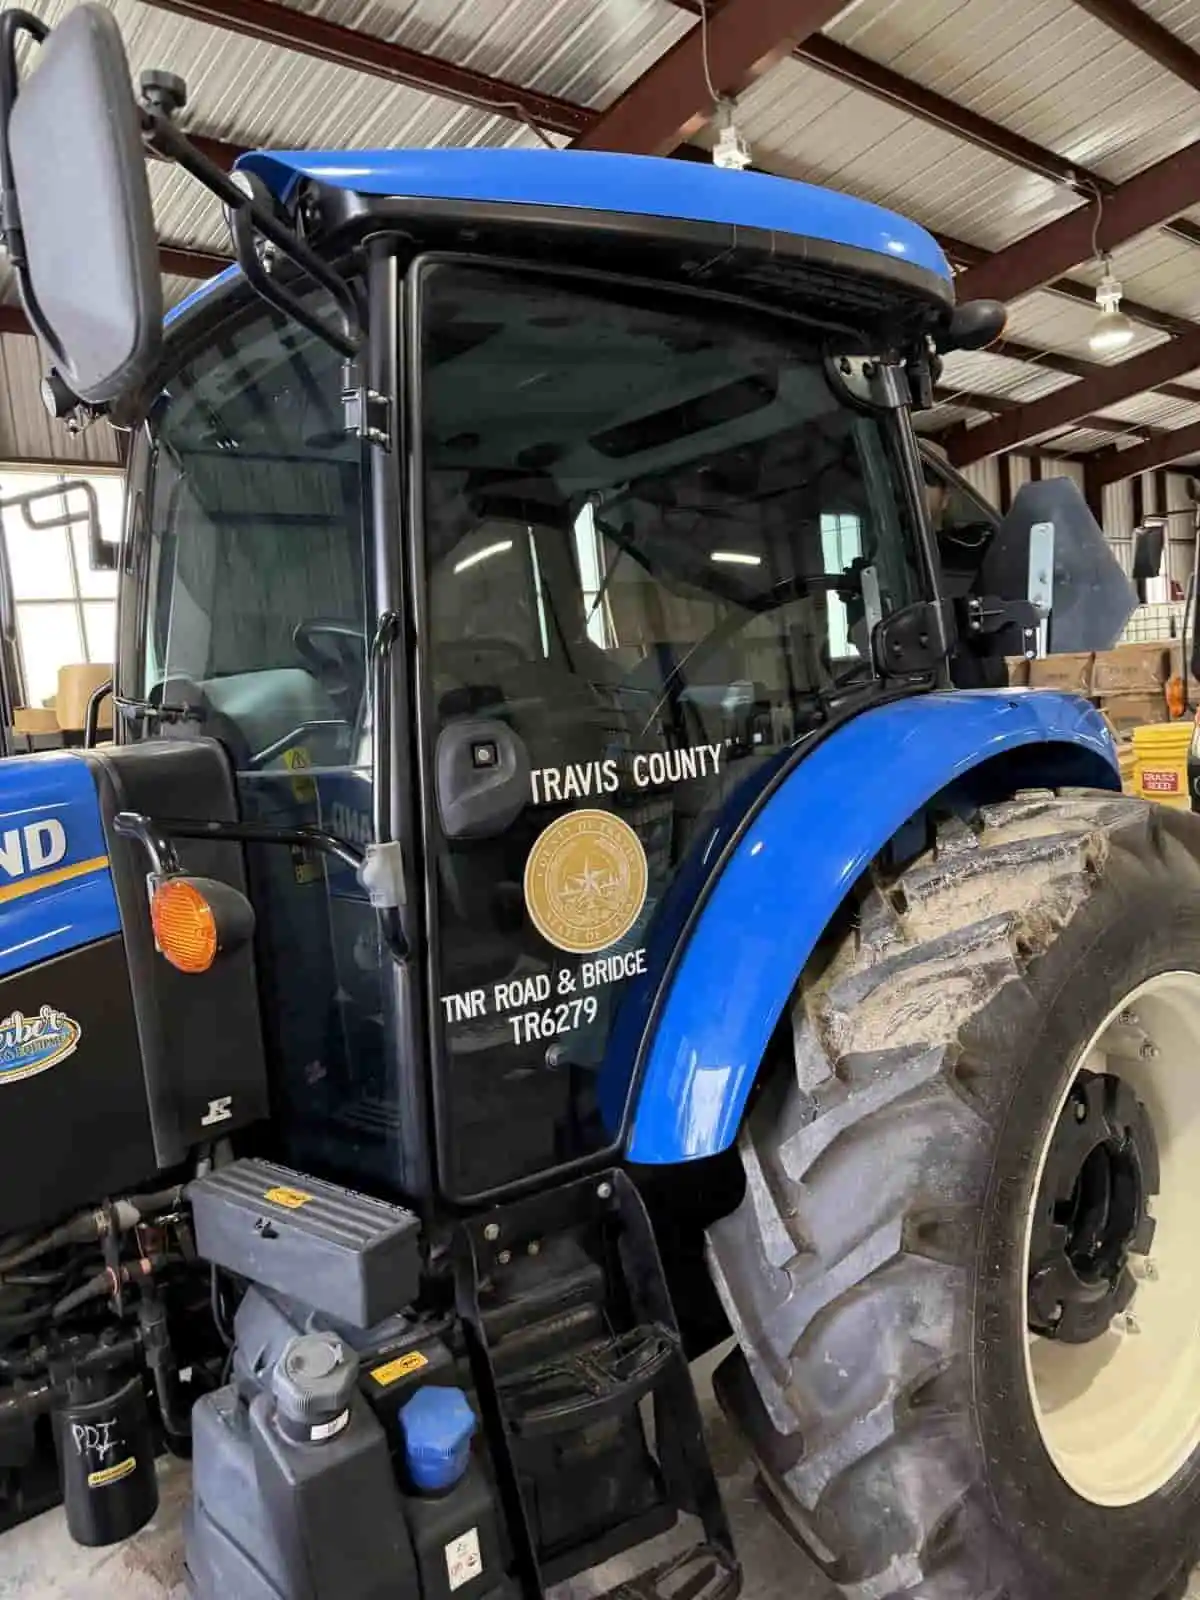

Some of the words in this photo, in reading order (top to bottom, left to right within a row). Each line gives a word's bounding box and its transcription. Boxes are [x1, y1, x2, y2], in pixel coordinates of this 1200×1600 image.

[529, 759, 620, 805] TRAVIS
[632, 742, 722, 788] COUNTY
[440, 989, 486, 1023] TNR
[494, 975, 551, 1012] ROAD
[557, 968, 577, 996] &
[582, 948, 649, 990] BRIDGE
[508, 996, 598, 1045] TR6279
